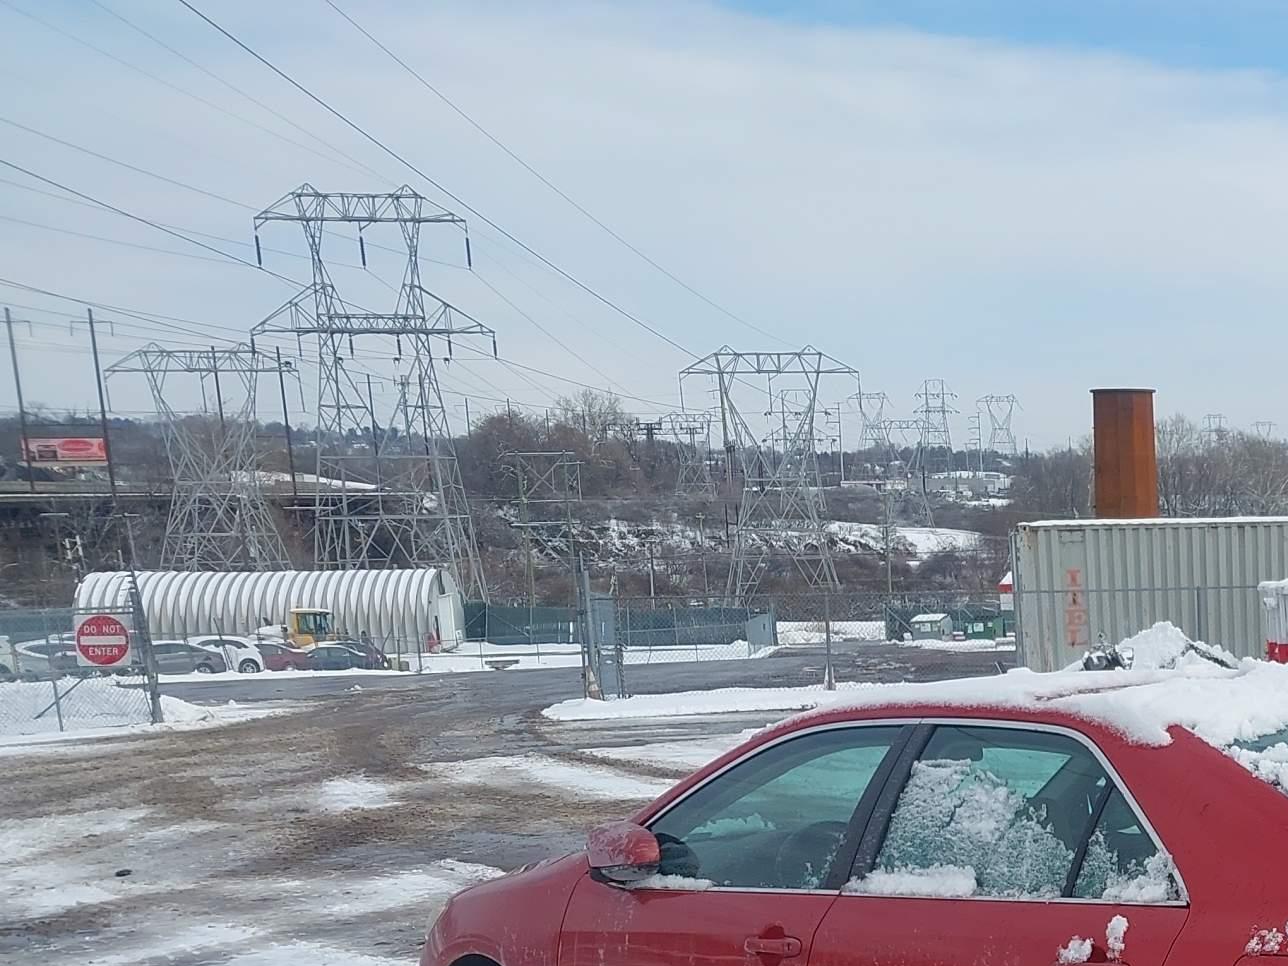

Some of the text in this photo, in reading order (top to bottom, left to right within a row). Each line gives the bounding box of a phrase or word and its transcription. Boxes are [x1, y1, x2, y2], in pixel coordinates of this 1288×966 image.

[83, 625, 121, 634] DO NOT
[88, 647, 119, 656] ENTER
